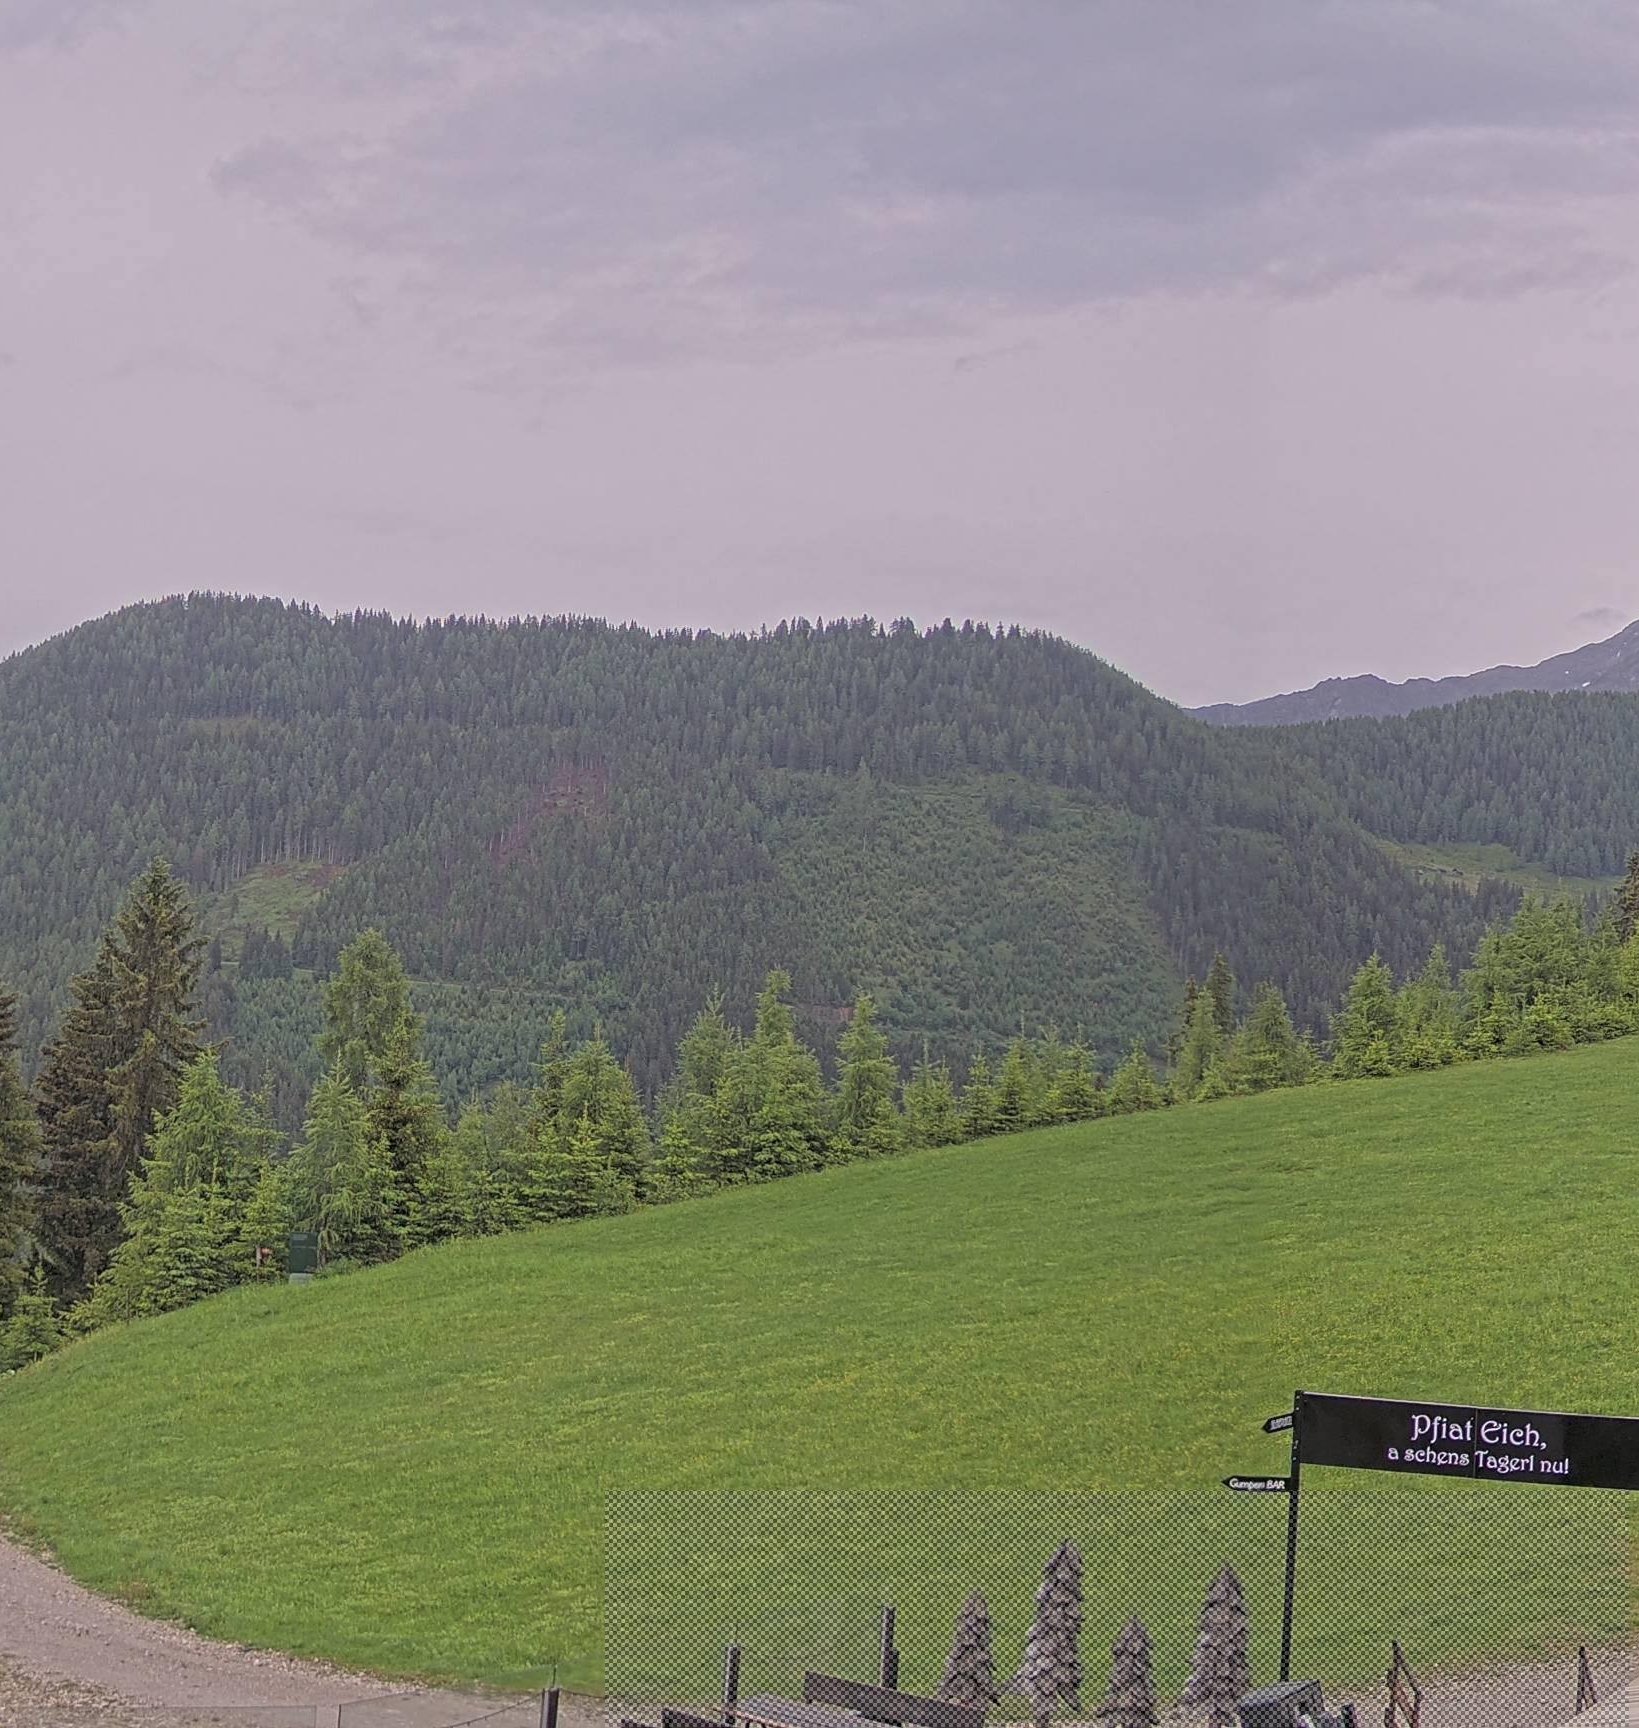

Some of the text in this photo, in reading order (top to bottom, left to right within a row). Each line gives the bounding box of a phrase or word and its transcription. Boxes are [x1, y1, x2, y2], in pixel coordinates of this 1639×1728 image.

[1411, 1414, 1547, 1450] Pfiat Eich,
[1388, 1446, 1570, 1475] a schens Tagerl nu!
[1266, 1479, 1286, 1490] BAR
